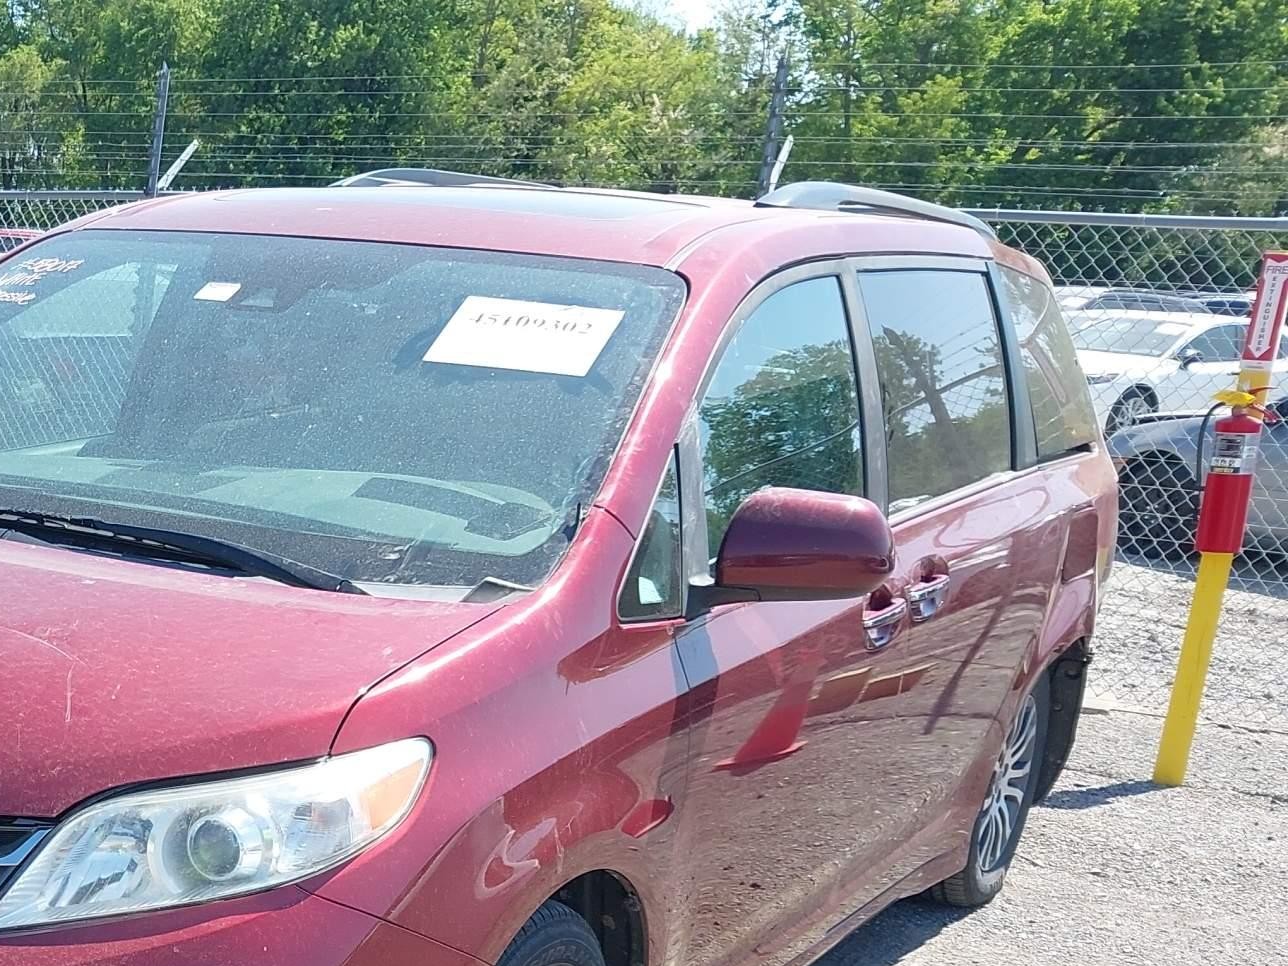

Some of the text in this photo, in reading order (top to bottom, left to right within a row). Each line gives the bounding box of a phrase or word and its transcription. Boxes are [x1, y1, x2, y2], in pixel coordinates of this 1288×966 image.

[1266, 264, 1288, 275] FIRE
[468, 312, 593, 335] 45109302
[1255, 276, 1277, 352] EXTINGUISHER
